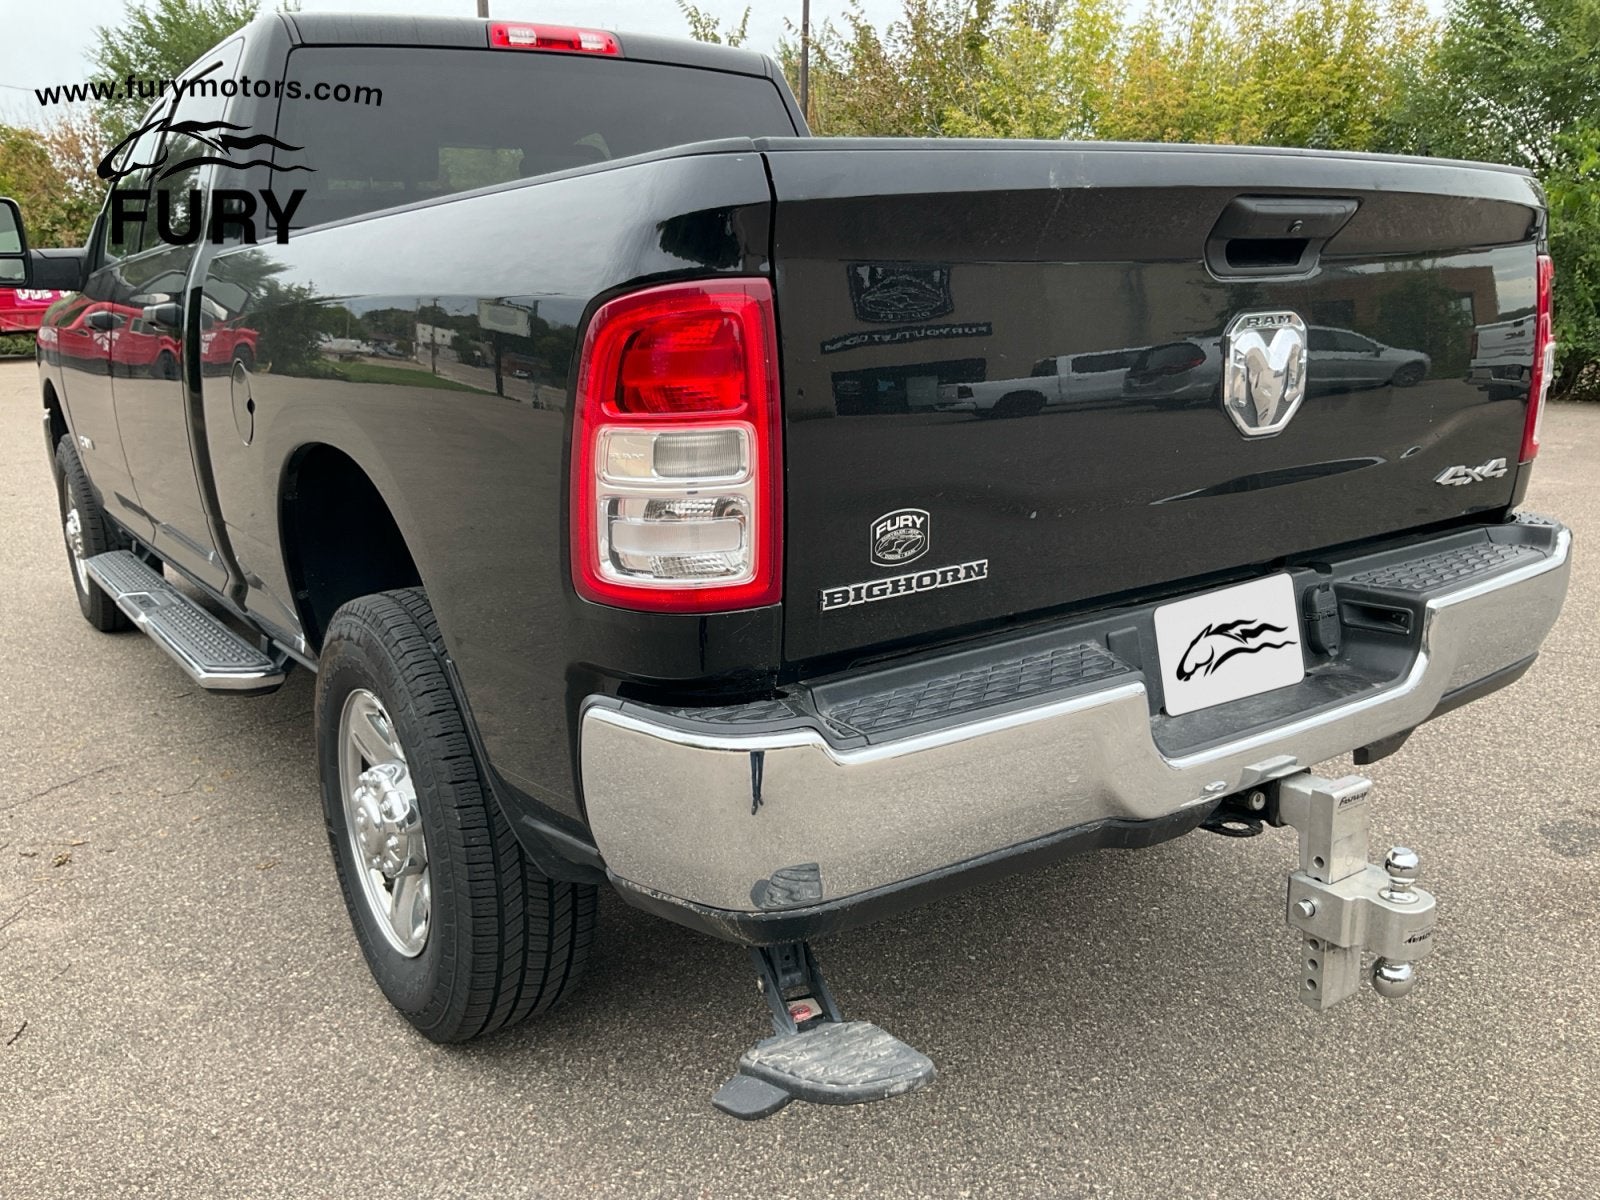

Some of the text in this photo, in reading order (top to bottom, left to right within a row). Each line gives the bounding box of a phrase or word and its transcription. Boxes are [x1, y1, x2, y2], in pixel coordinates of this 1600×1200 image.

[1247, 315, 1292, 327] RAM
[876, 515, 925, 540] FURY
[822, 559, 988, 611] BIGHORN
